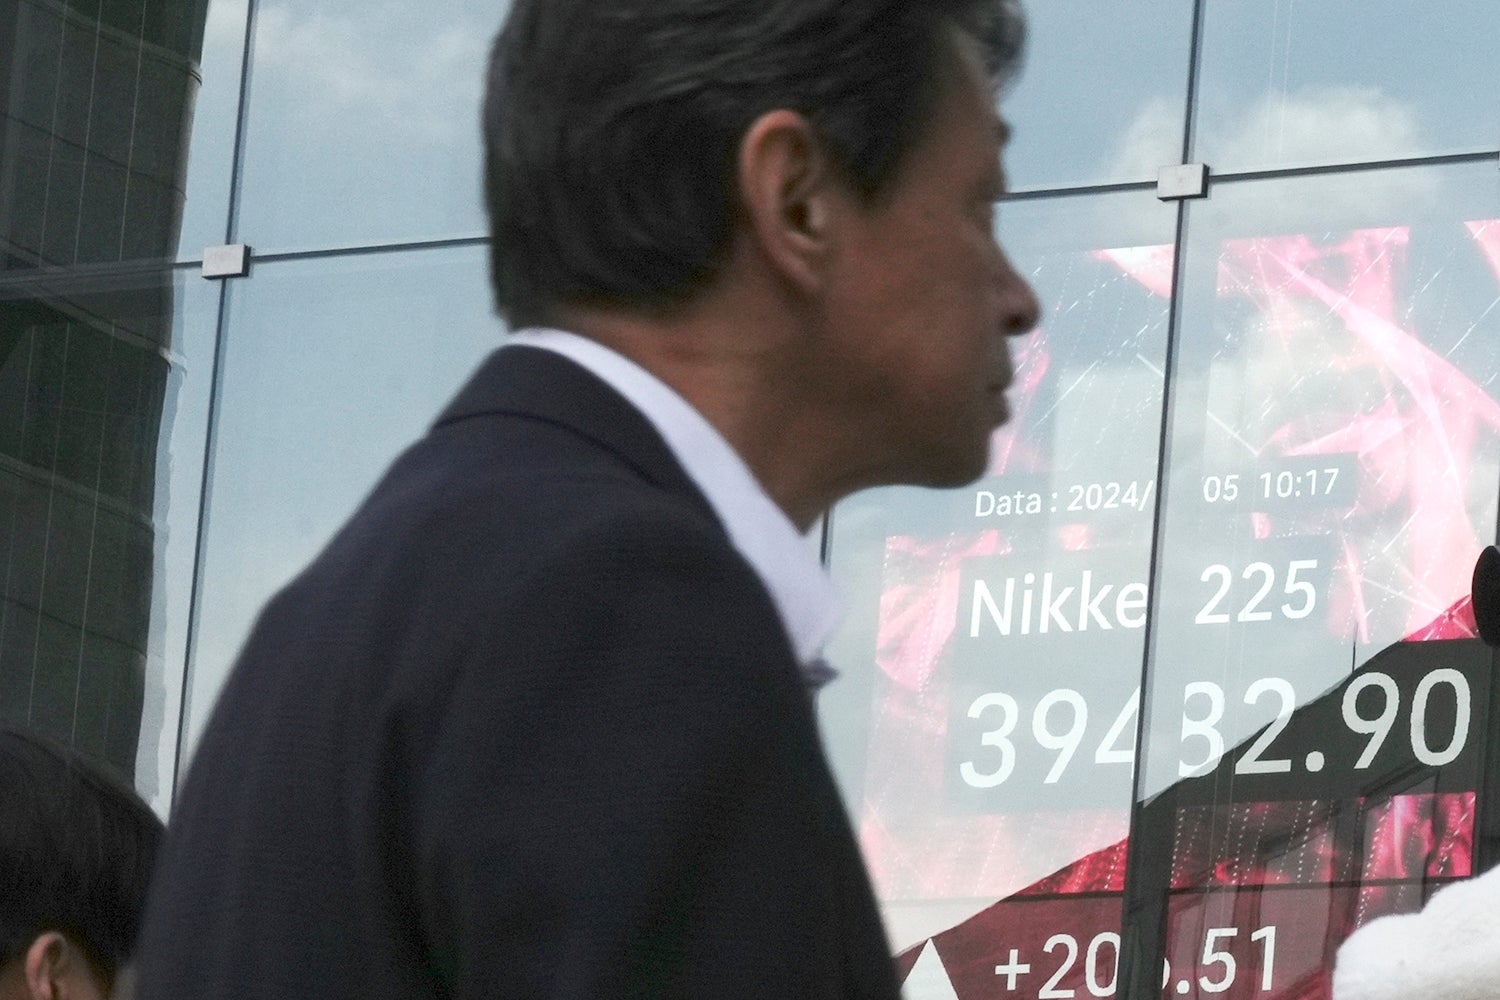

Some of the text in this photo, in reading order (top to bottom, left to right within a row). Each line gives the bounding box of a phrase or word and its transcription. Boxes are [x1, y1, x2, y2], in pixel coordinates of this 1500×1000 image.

[1259, 468, 1340, 499] 10:17
[970, 559, 1318, 638] Nikke 225
[994, 925, 1276, 1000] +20.51
